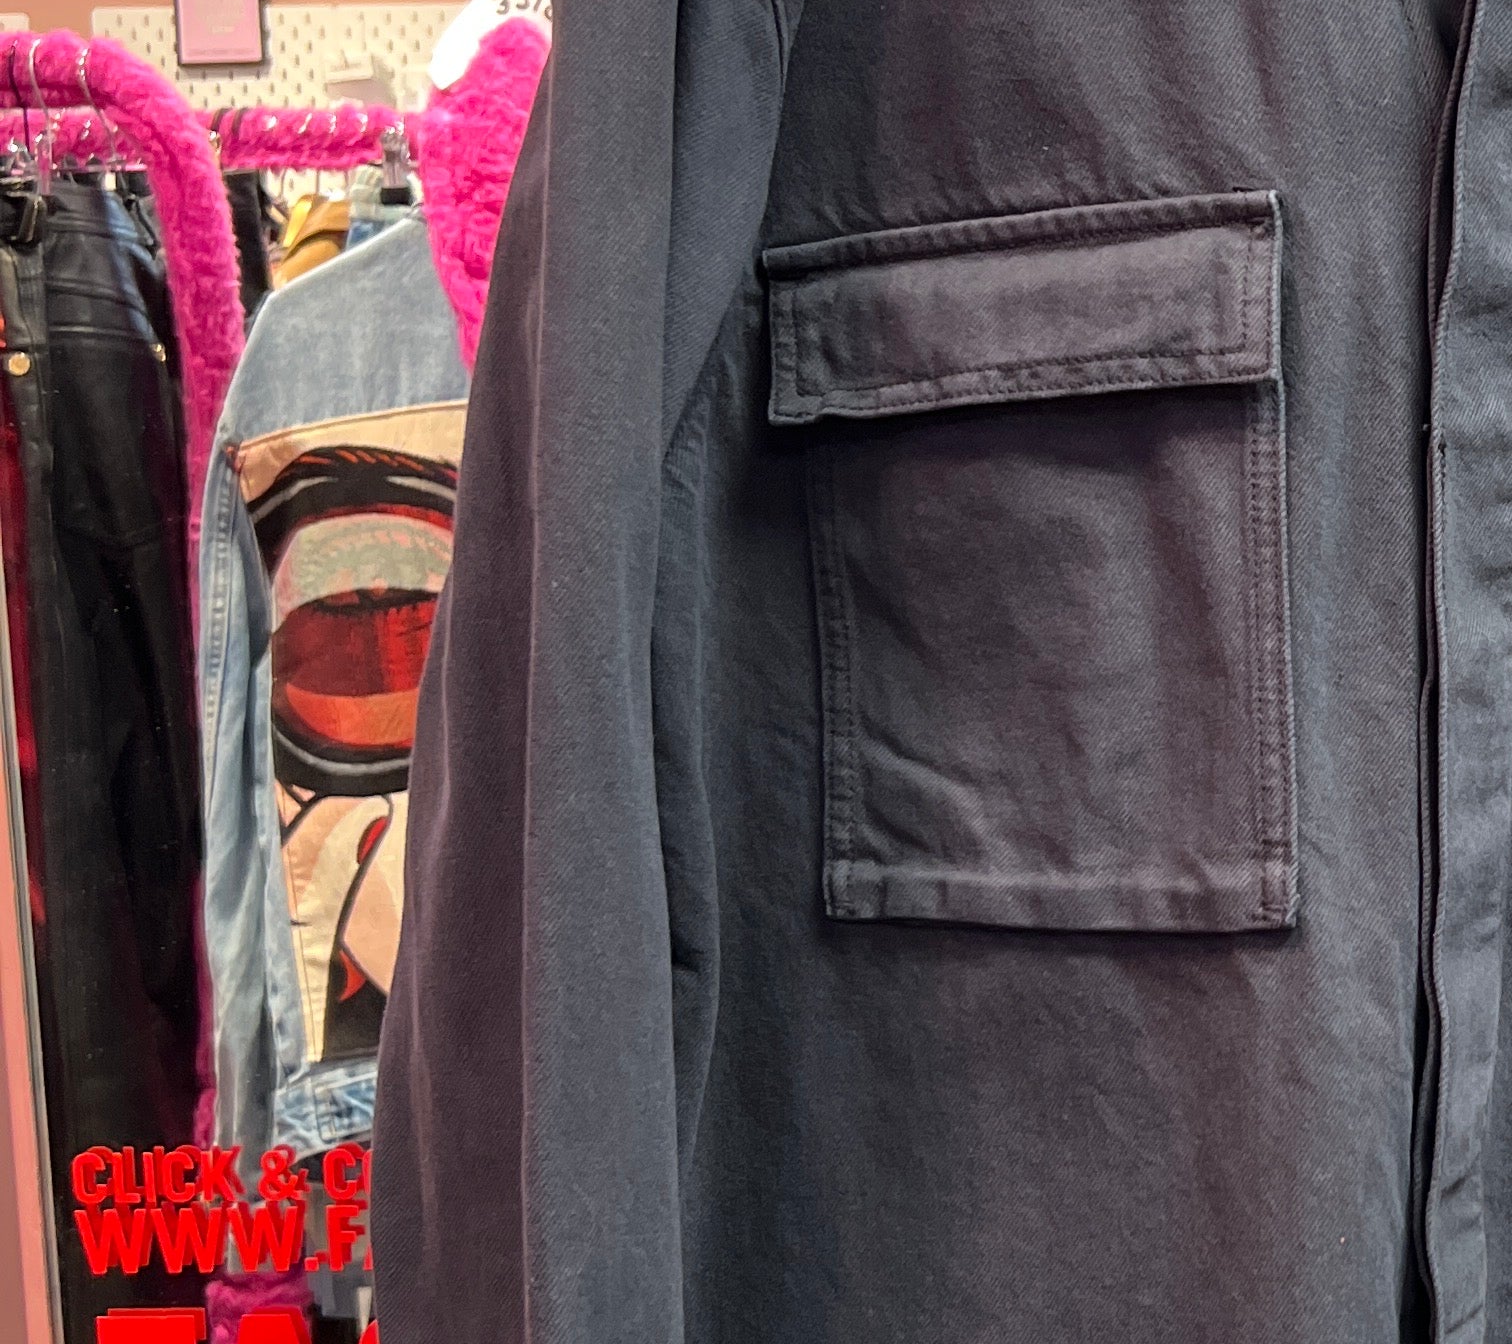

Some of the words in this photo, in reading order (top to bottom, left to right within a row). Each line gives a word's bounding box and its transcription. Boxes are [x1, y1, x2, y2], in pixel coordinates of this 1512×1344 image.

[73, 1151, 236, 1204] CLICK
[258, 1149, 299, 1201] &
[74, 1205, 373, 1274] WWW.F
